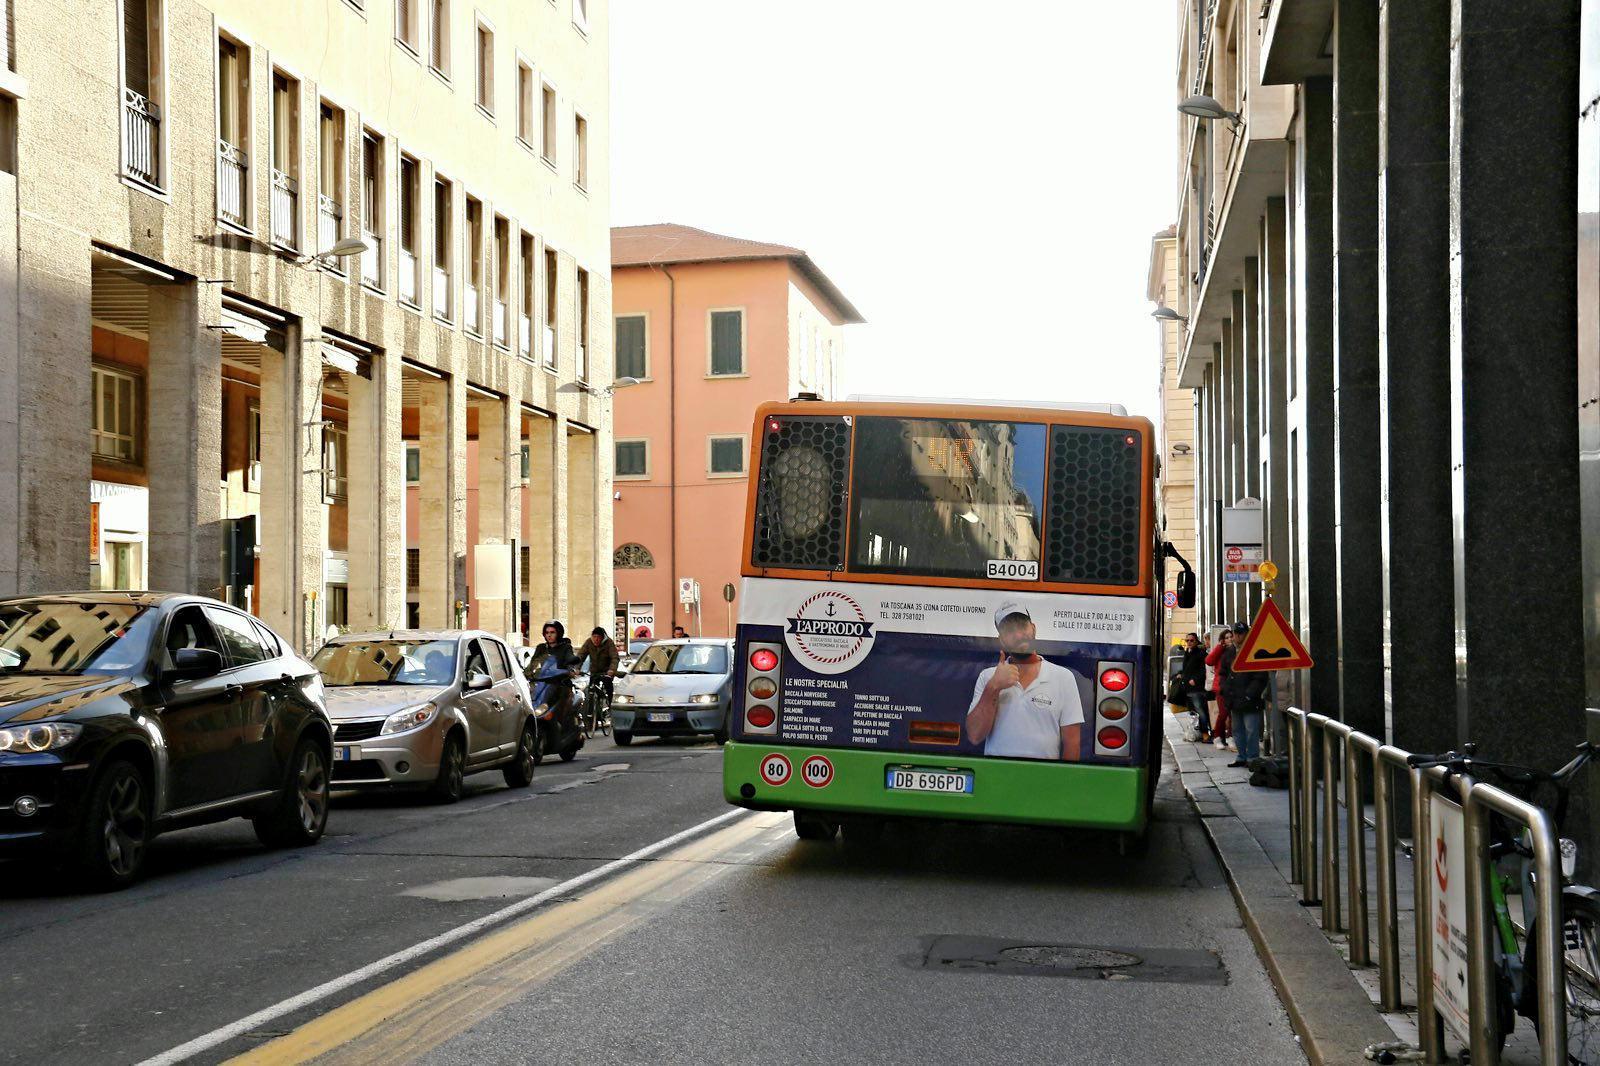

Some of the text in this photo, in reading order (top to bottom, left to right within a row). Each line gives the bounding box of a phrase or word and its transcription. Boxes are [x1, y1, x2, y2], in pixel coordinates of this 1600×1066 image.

[988, 564, 1036, 577] B4004
[891, 602, 914, 610] TOSCANA
[796, 620, 864, 636] L'APPRODO
[786, 678, 848, 689] LE NOSTRE SPECIALITÀ
[768, 763, 783, 776] 80
[808, 764, 828, 778] 100
[896, 773, 913, 788] DB
[919, 774, 964, 790] 696PD
